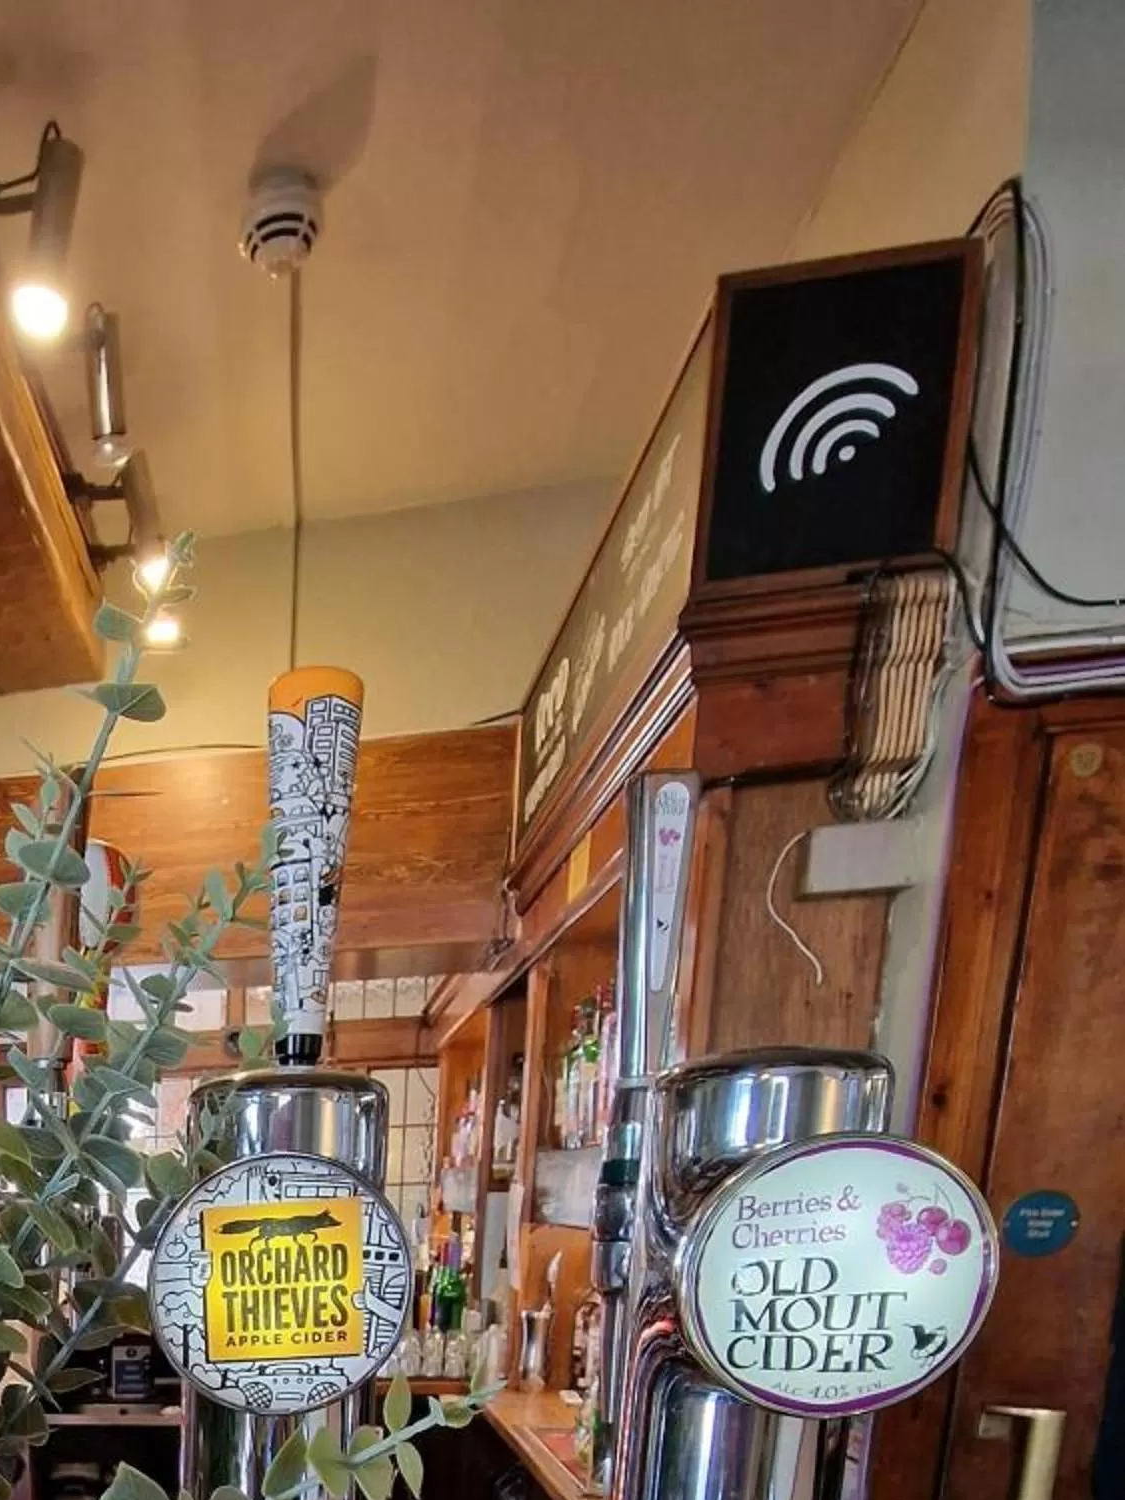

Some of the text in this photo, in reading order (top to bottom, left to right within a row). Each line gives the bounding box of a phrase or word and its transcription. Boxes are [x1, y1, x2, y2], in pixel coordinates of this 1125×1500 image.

[733, 1185, 863, 1222] Berries &
[731, 1220, 848, 1249] Cherries
[220, 1244, 349, 1288] ORCHARD
[731, 1256, 839, 1296] OLD
[221, 1284, 349, 1333] THIEVES
[729, 1291, 909, 1333] MOUT
[225, 1330, 348, 1348] APPLE CIDER
[726, 1333, 896, 1374] CIDER
